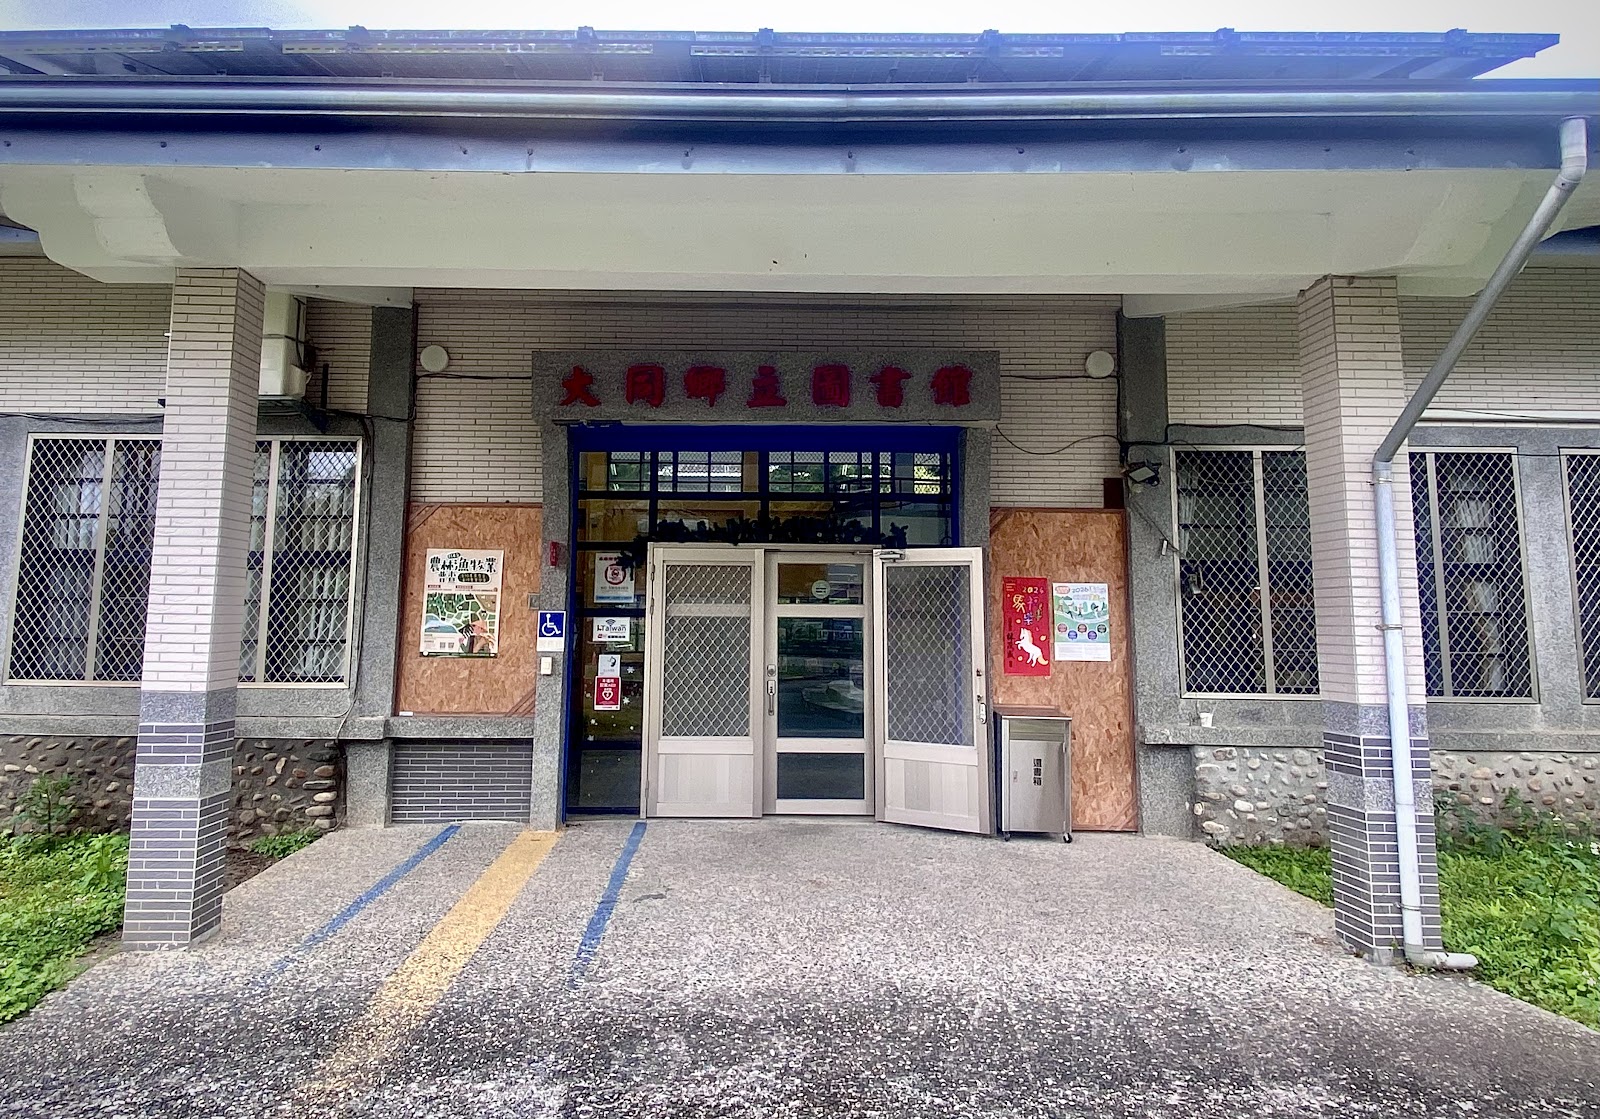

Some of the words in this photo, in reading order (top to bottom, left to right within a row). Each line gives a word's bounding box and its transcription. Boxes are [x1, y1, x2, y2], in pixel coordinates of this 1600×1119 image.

[560, 364, 974, 408] 大同鄉立圖書館
[430, 556, 497, 573] 農林漁牧業
